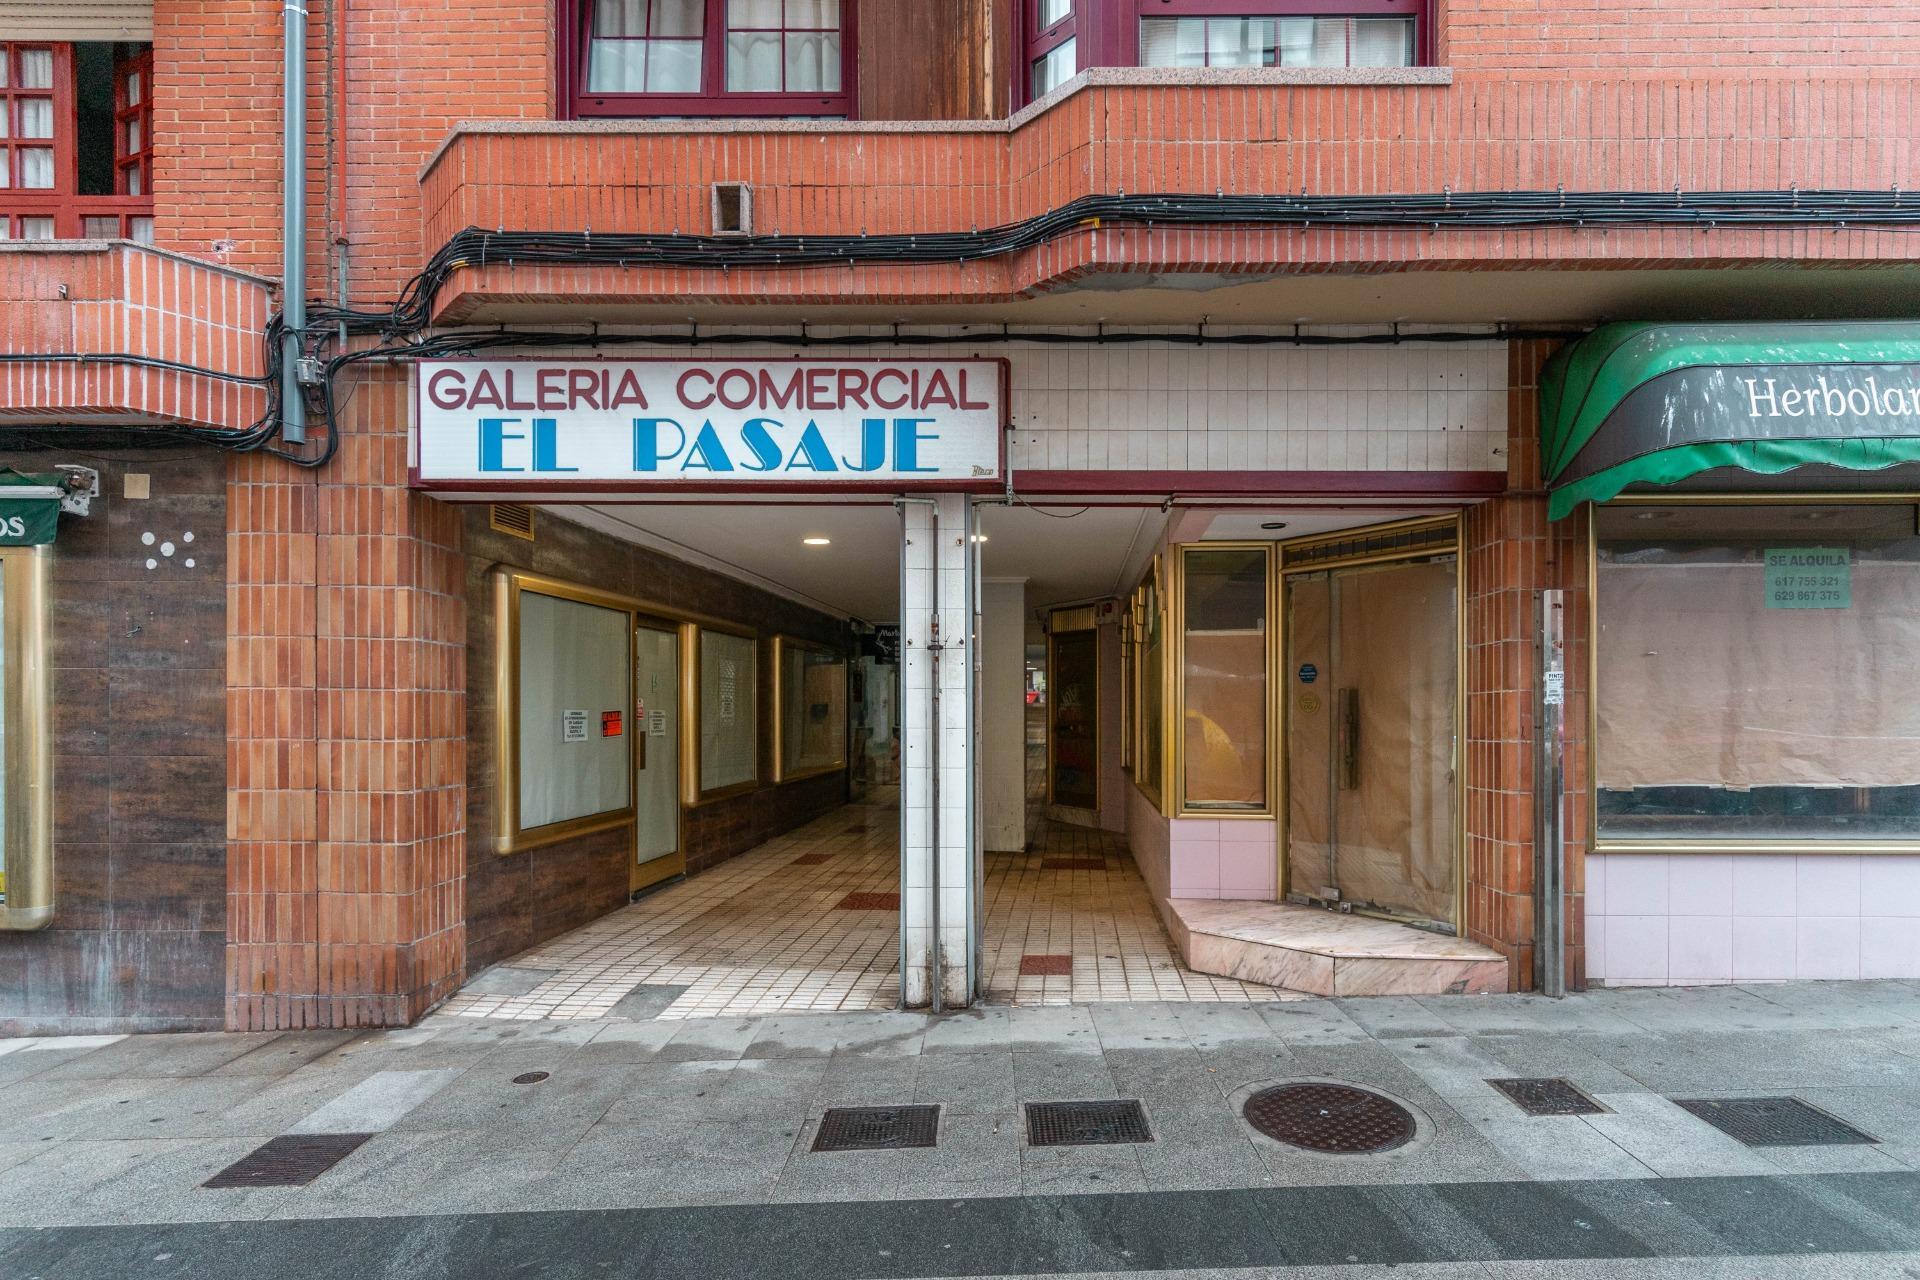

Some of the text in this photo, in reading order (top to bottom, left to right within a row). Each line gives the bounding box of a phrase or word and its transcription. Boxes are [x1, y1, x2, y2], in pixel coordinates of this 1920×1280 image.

[428, 368, 989, 410] GALERIA COMERCIAL
[478, 417, 939, 472] EL PASAJE
[1769, 555, 1846, 566] SE ALQUILA
